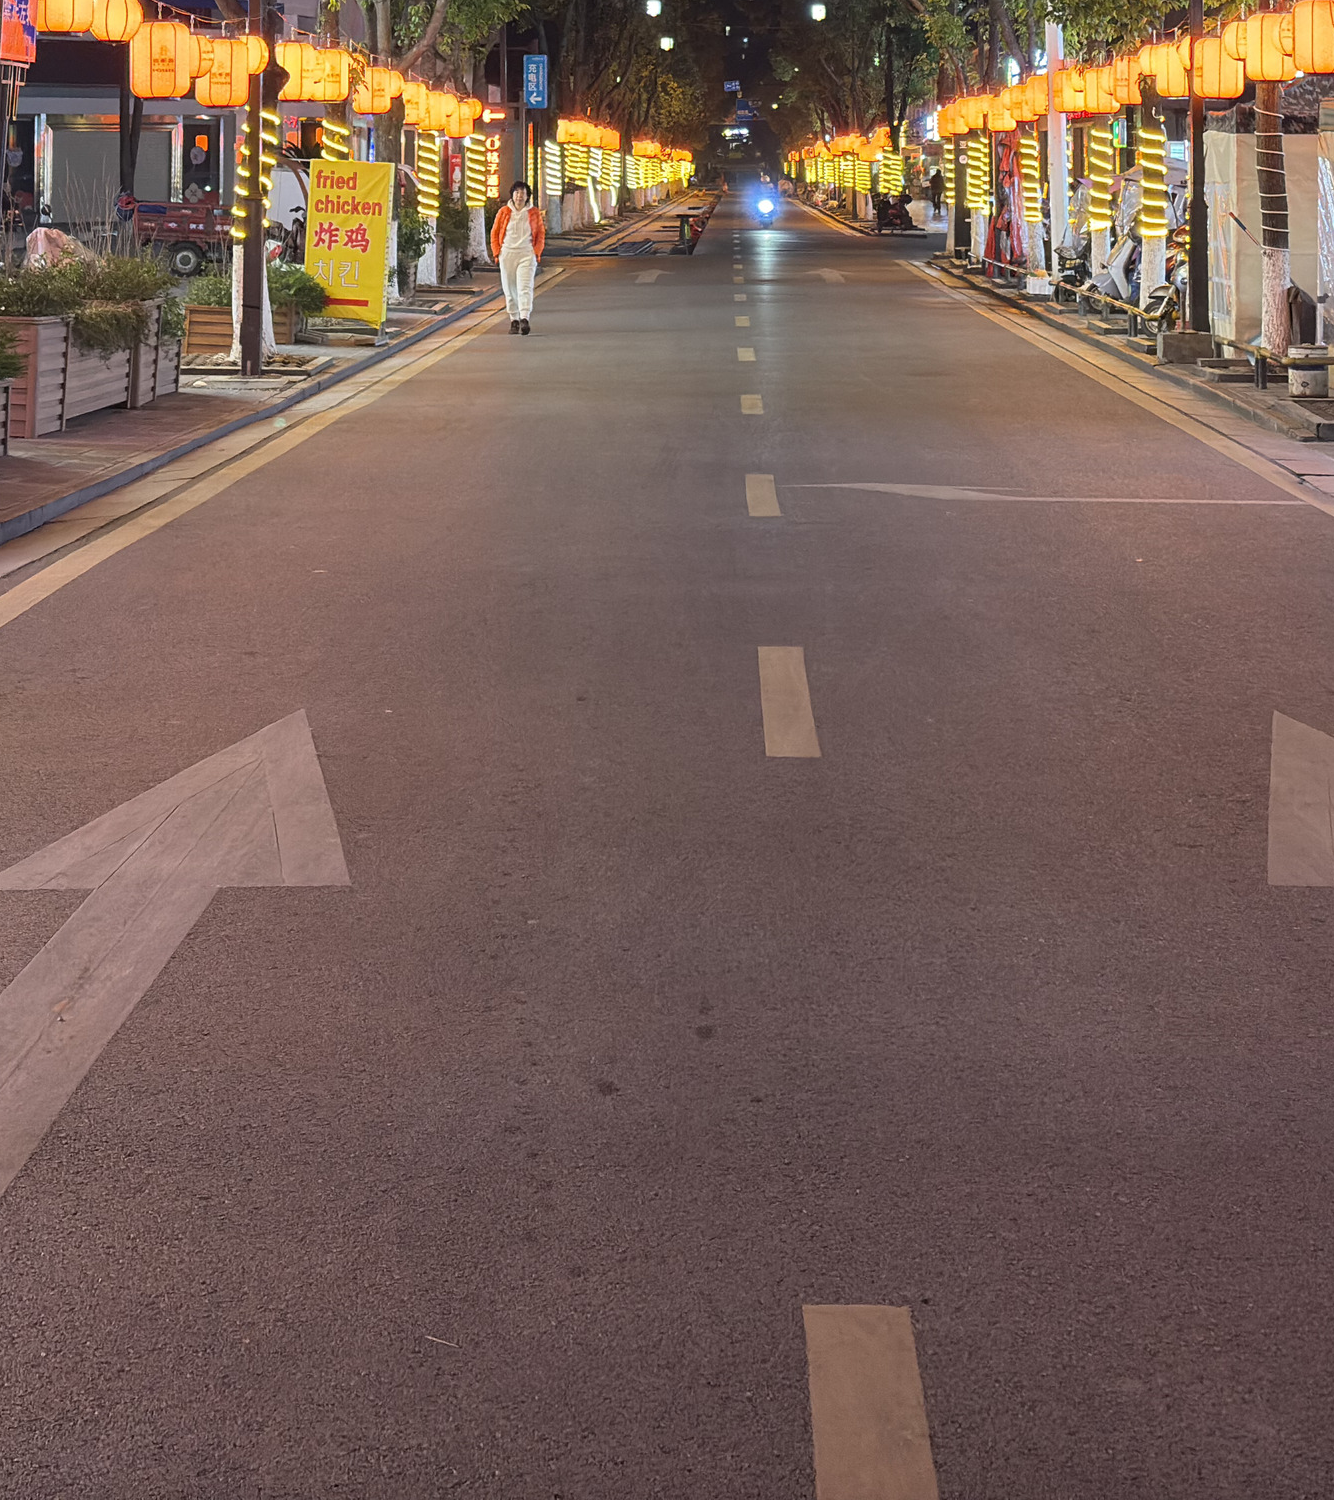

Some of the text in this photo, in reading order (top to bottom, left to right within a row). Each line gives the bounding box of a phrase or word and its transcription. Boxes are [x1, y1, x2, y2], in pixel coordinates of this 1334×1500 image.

[528, 64, 537, 92] 充电区
[315, 169, 358, 191] fried
[314, 195, 383, 217] chicken
[313, 221, 371, 254] 炸鸡
[313, 258, 360, 288] 치킨
